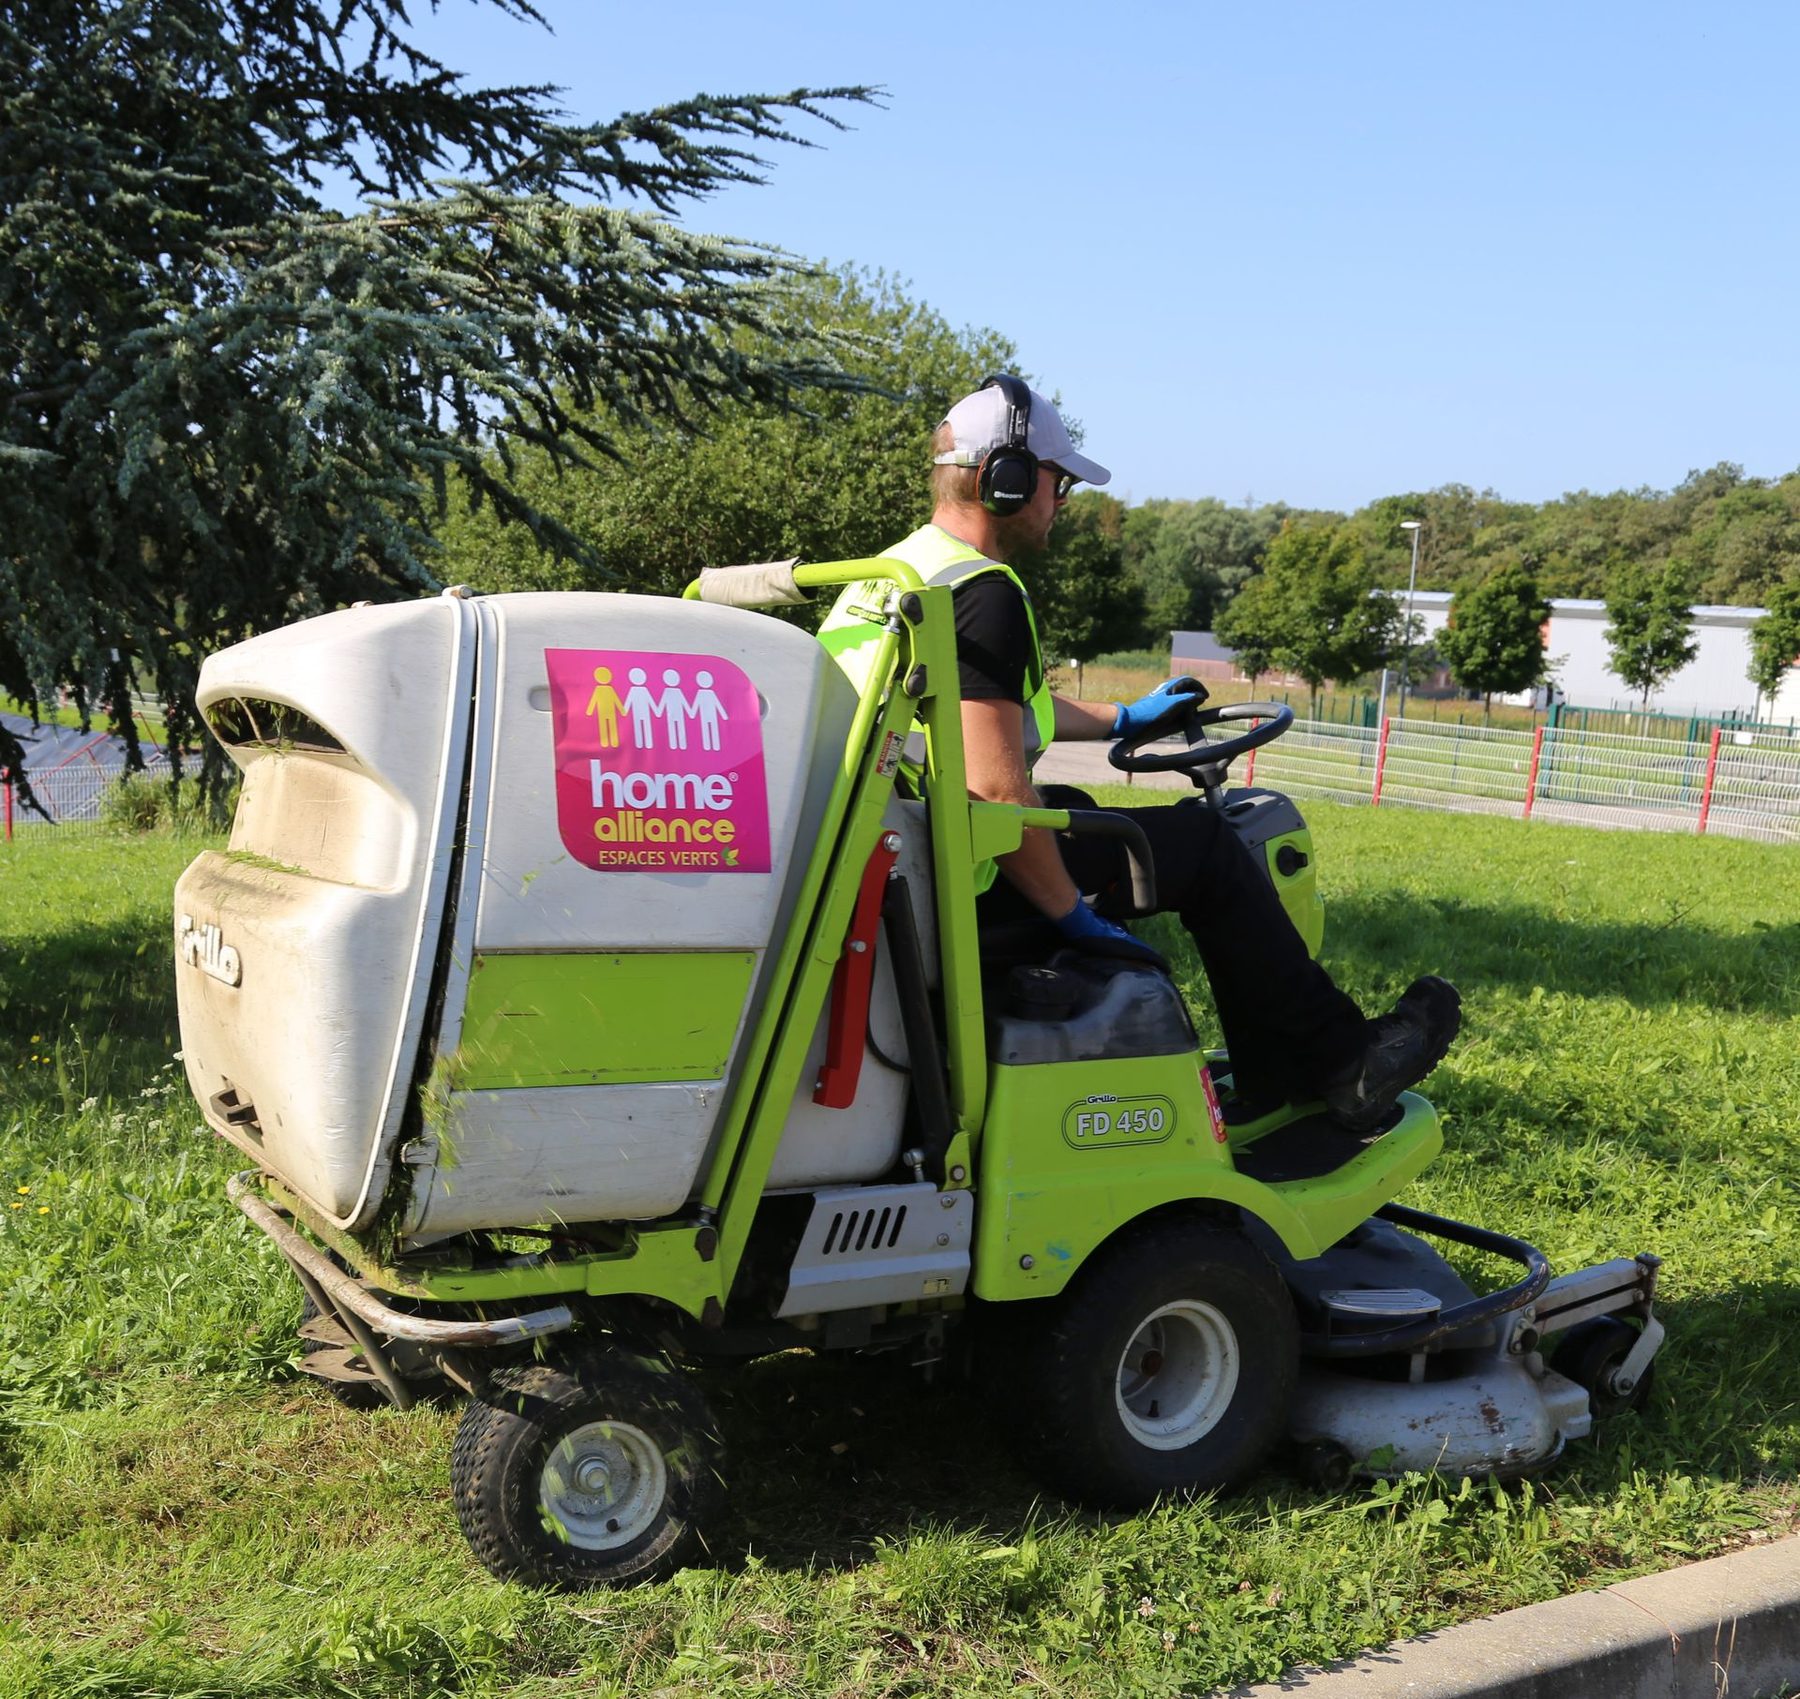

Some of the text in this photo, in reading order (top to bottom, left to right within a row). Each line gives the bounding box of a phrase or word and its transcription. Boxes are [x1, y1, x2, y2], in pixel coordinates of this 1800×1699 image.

[594, 811, 736, 843] alliance
[599, 850, 719, 866] ESPACES VERTS
[1076, 1107, 1165, 1137] FD 450
